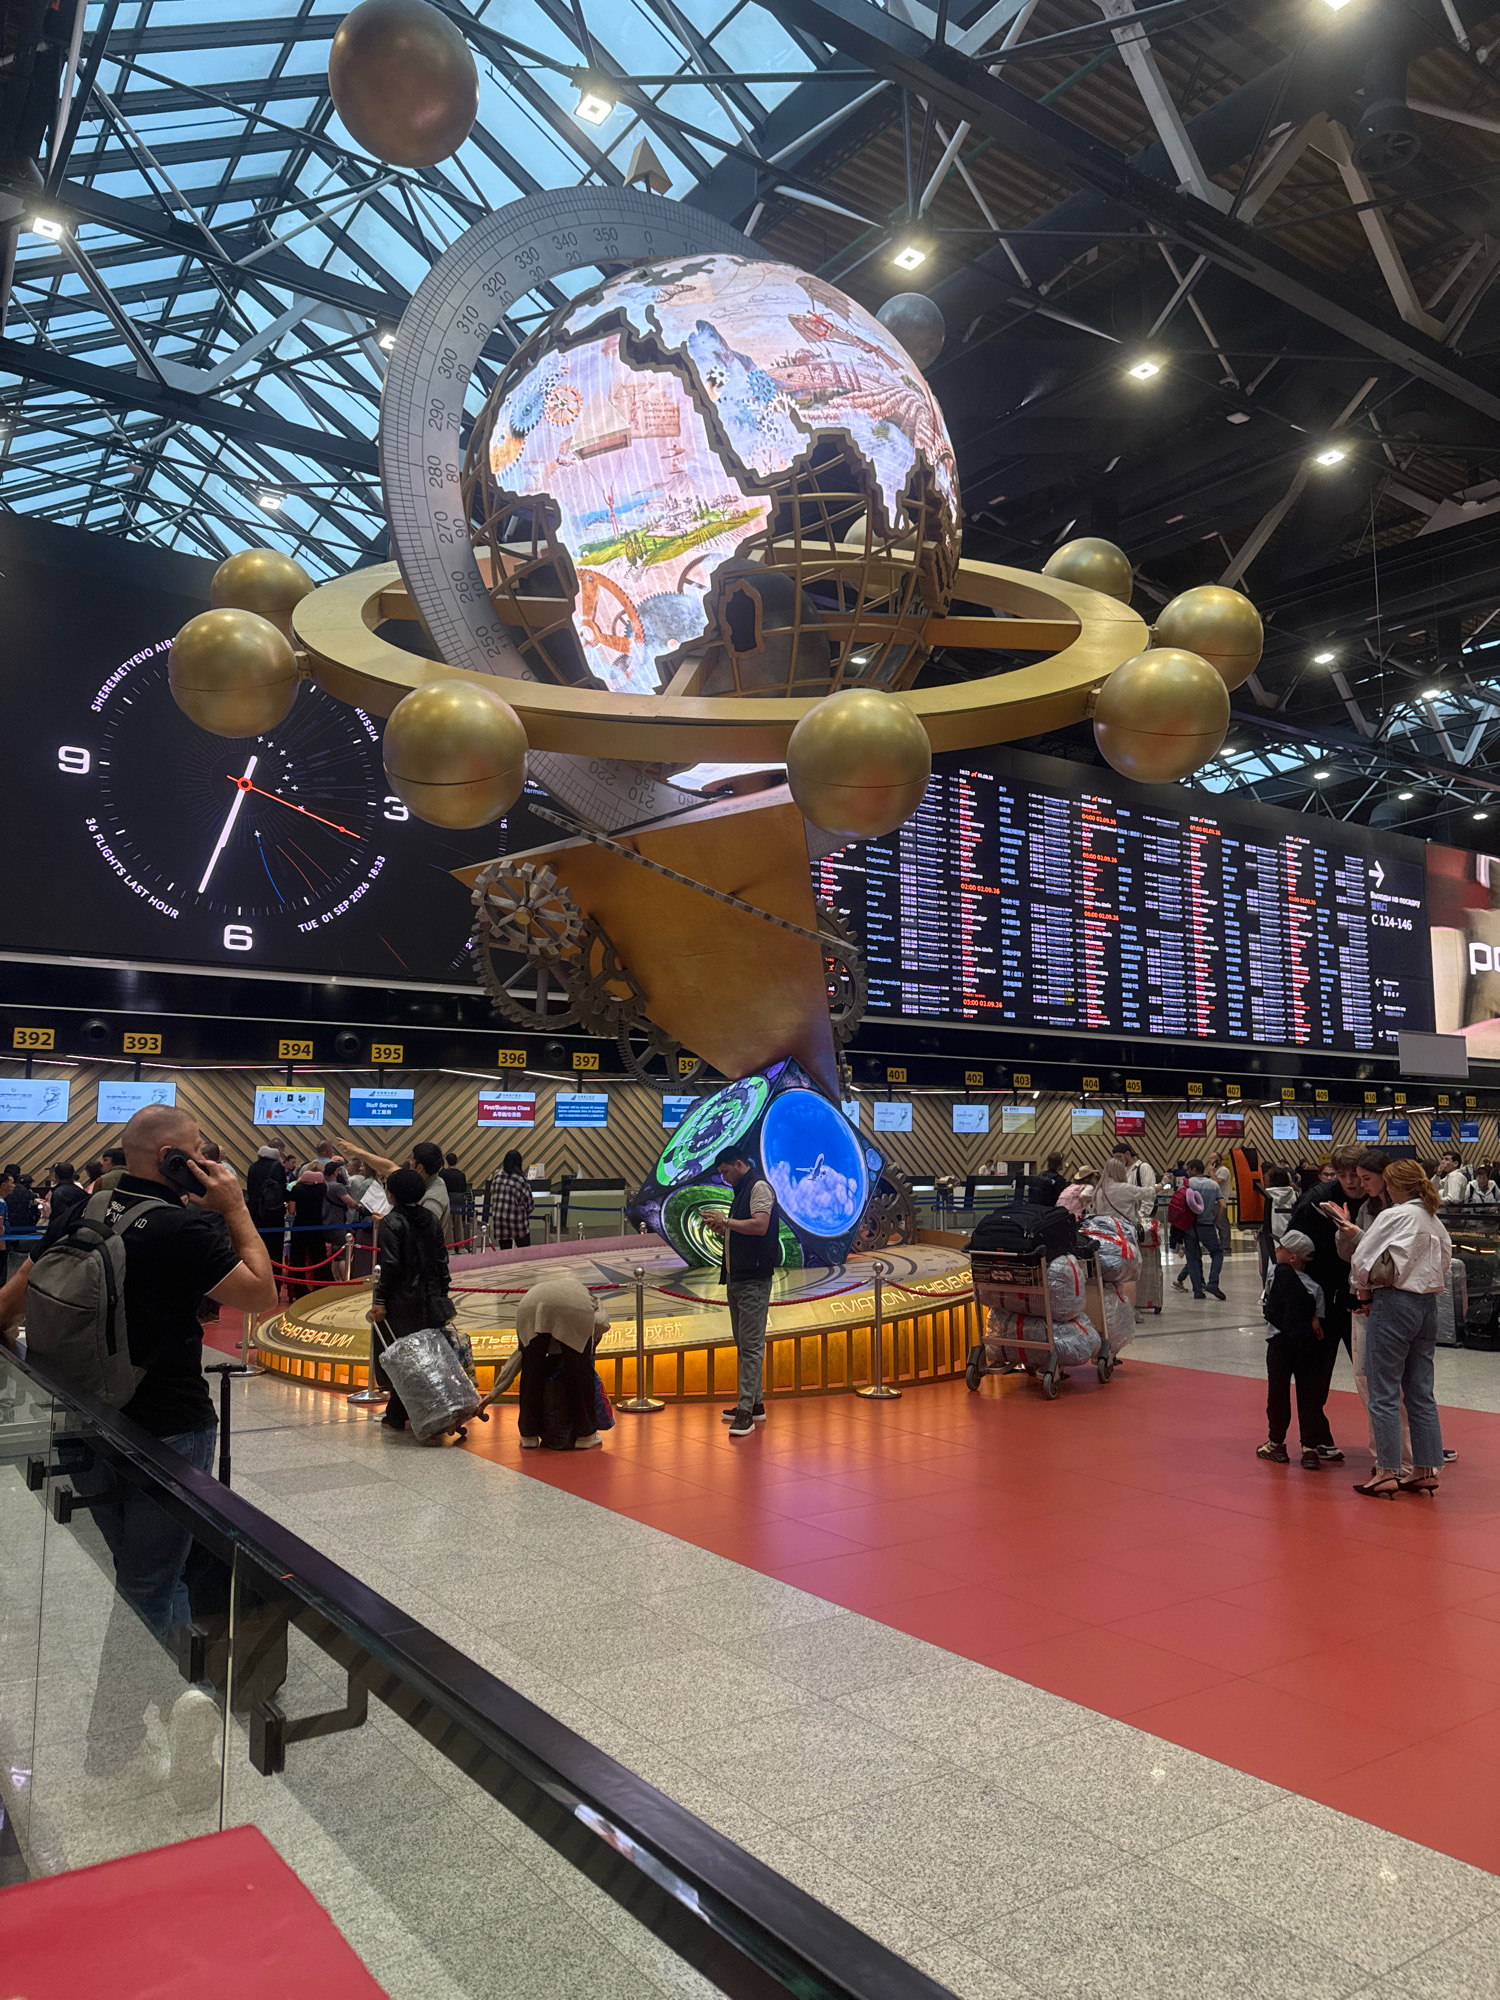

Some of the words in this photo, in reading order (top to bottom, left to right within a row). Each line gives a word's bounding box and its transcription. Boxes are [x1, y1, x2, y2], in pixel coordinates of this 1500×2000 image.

[552, 232, 578, 251] 340
[593, 227, 619, 243] 350
[644, 231, 652, 244] 0
[514, 247, 540, 270] 330
[564, 251, 582, 265] 20
[604, 245, 620, 258] 10
[529, 266, 545, 283] 30
[482, 271, 507, 298] 320
[498, 290, 515, 308] 40
[456, 305, 480, 335] 310
[474, 322, 490, 342] 50
[438, 347, 458, 379] 300
[456, 363, 471, 384] 60
[428, 398, 445, 431] 290
[446, 412, 460, 430] 70
[427, 455, 443, 489] 280
[446, 463, 459, 483] 80
[434, 511, 453, 544] 270
[453, 518, 468, 538] 90
[452, 571, 473, 603] 260
[476, 625, 501, 658] 250
[91, 648, 154, 712] SHEREMETYEVO
[355, 707, 379, 742] RUSSIA
[58, 745, 92, 774] 9
[589, 761, 617, 786] 220
[635, 773, 658, 793] 150
[628, 787, 655, 809] 210
[383, 796, 409, 821] 3
[500, 818, 507, 829] 16
[85, 817, 99, 832] 36
[93, 833, 127, 876] FLIGHTS
[123, 875, 150, 897] LAST
[147, 895, 179, 919] HOUR
[297, 919, 319, 933] TUE
[321, 912, 334, 923] 01
[333, 900, 350, 916] SEP
[349, 881, 370, 903] 2026
[368, 855, 386, 879] 18:33
[960, 883, 976, 891] 02:00
[977, 885, 1000, 895] 02.09.26
[1371, 913, 1378, 925] C
[1379, 915, 1413, 931] 124-146
[223, 924, 253, 951] 6
[1469, 942, 1500, 975] p
[979, 1000, 1003, 1009] 02.09.26
[17, 1031, 51, 1046] 392
[127, 1037, 158, 1050] 393
[282, 1043, 311, 1056] 394
[374, 1048, 400, 1060] 395
[501, 1053, 524, 1064] 396
[575, 1056, 597, 1067] 397
[680, 1060, 697, 1071] 39
[888, 1068, 906, 1082] 401
[967, 1074, 982, 1083] 402
[1015, 1074, 1030, 1085] 403
[1084, 1080, 1098, 1088] 404
[1126, 1080, 1140, 1092] 405
[1189, 1085, 1202, 1093] 406
[1228, 1085, 1239, 1095] 407
[1283, 1088, 1294, 1097] 408
[1317, 1090, 1328, 1099] 409
[1366, 1092, 1376, 1101] 410
[1396, 1093, 1406, 1101] 411
[111, 1201, 126, 1213] 960
[297, 1329, 355, 1348] АВИАЦИИ
[470, 1335, 518, 1344] ЕТЬЕВ
